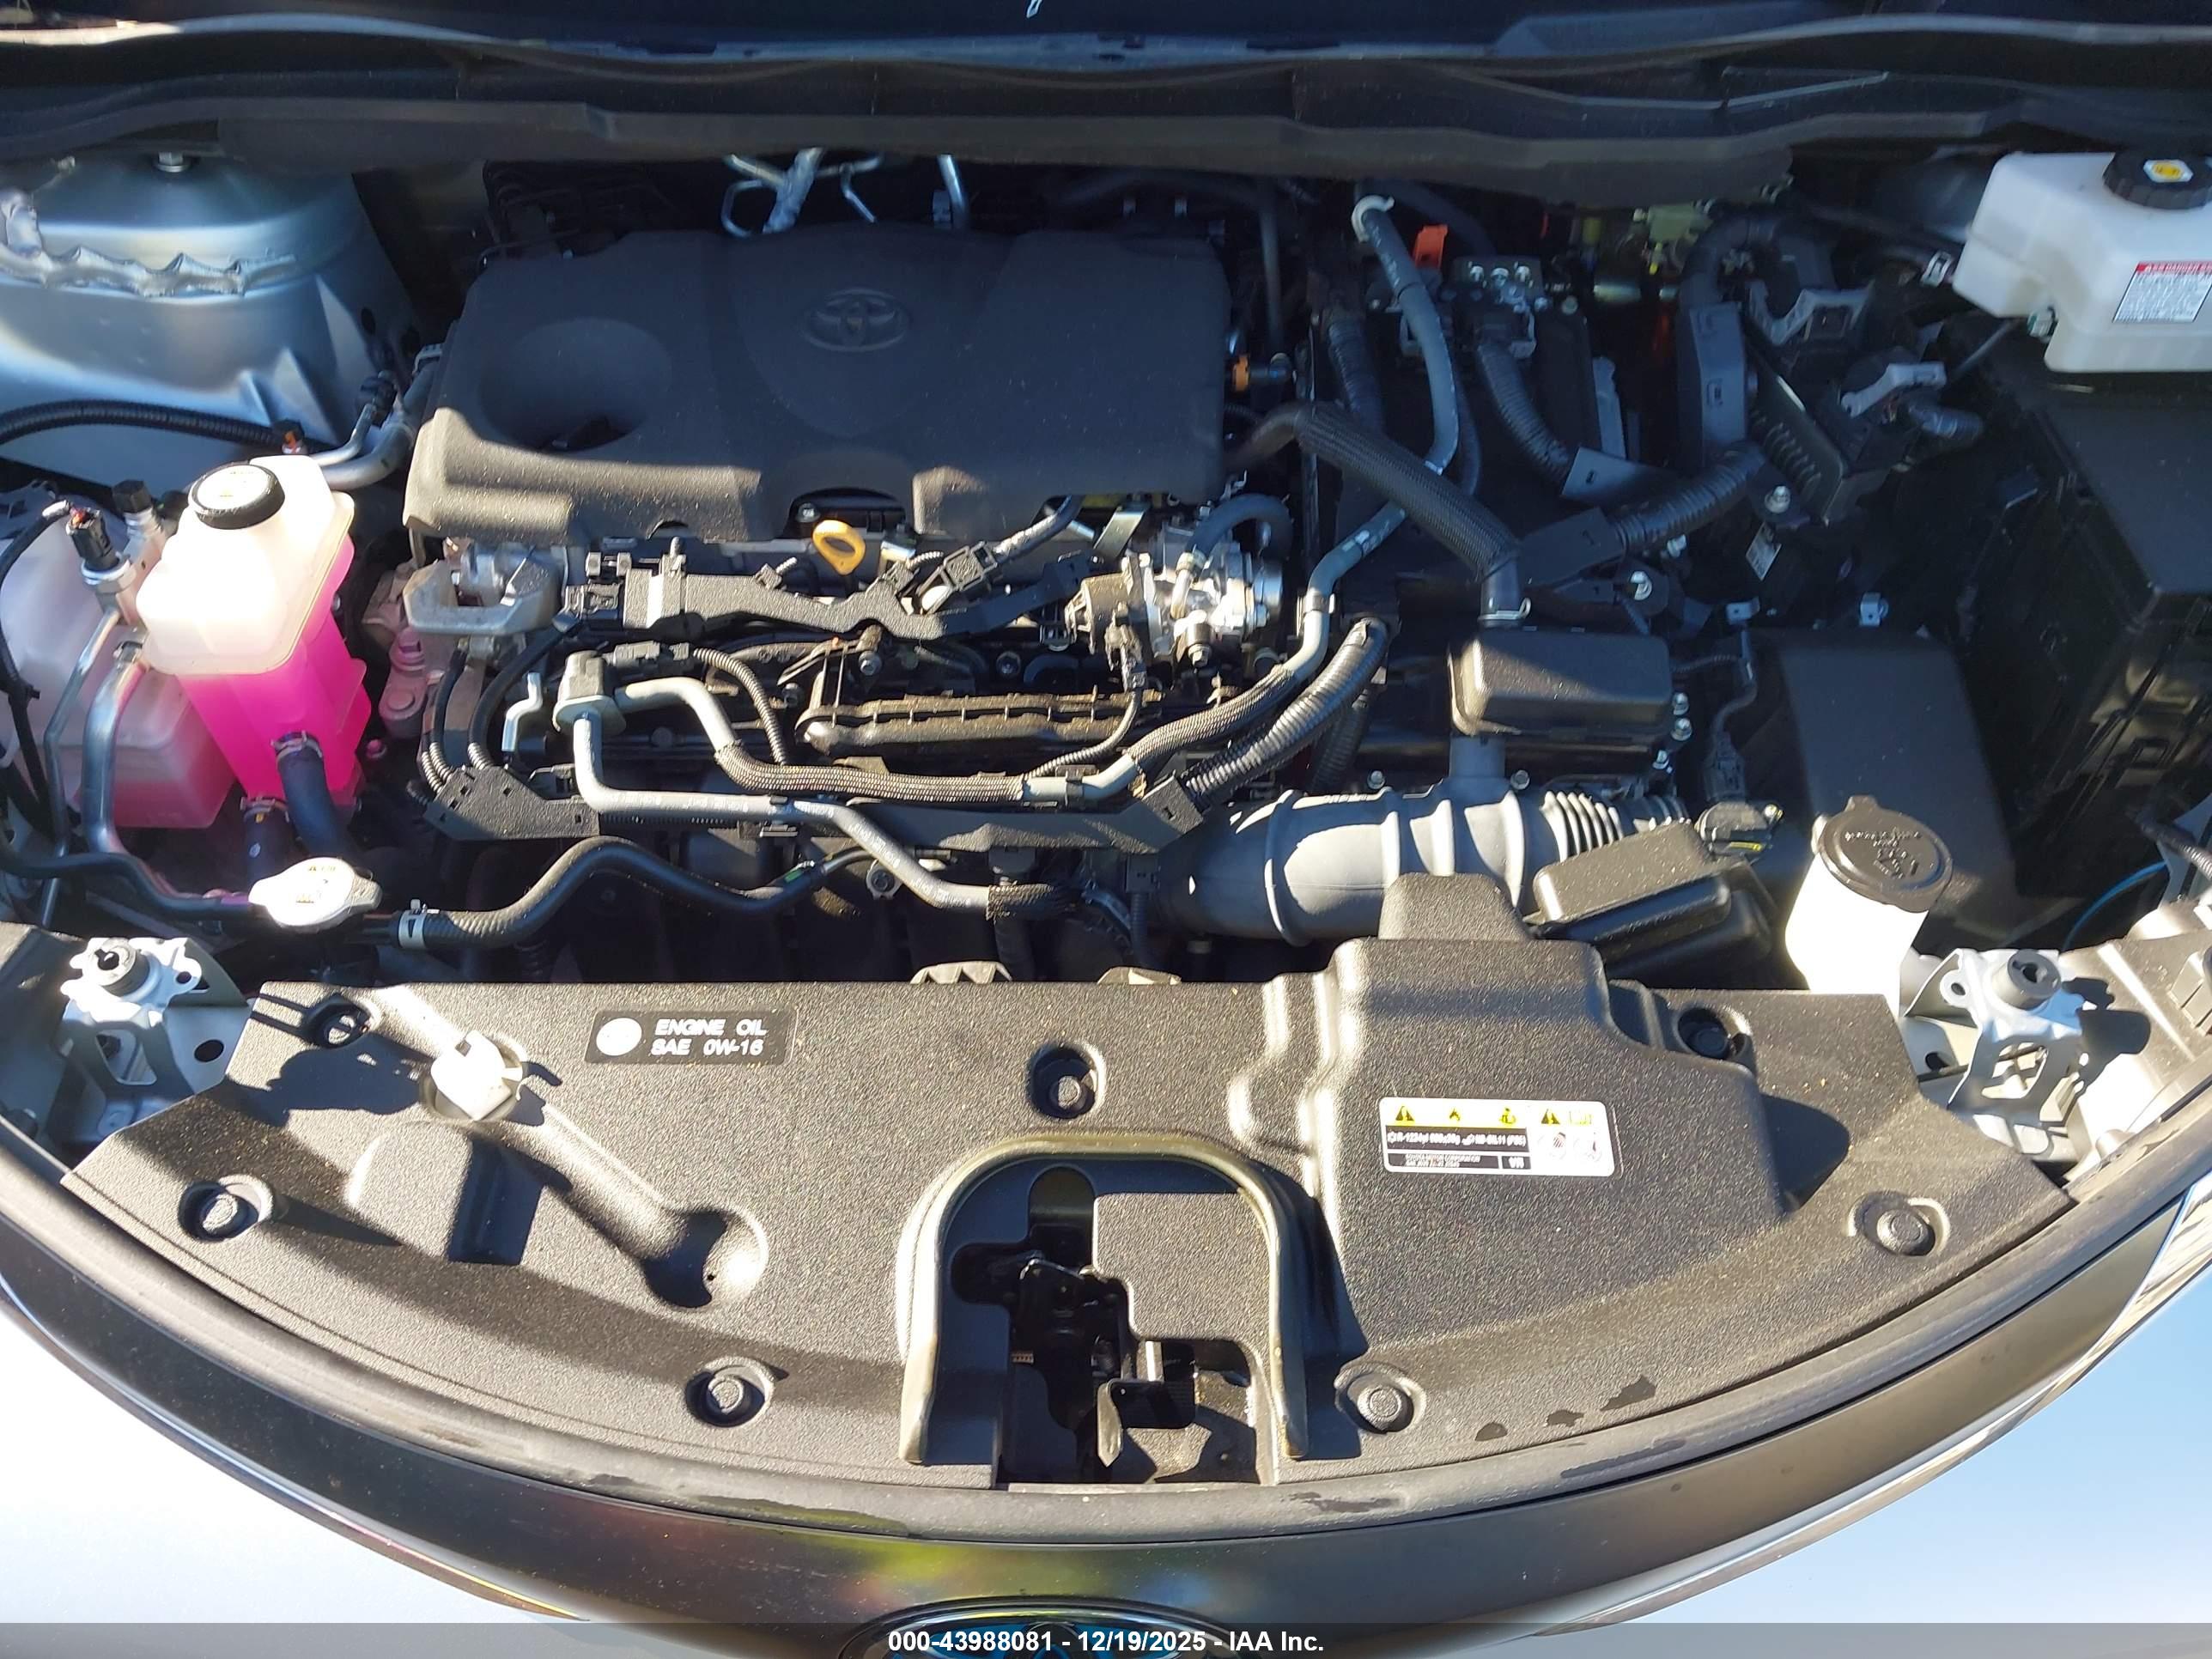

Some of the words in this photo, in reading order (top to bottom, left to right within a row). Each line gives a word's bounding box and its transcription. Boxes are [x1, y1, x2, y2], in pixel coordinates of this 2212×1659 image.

[655, 1018, 726, 1036] ENGINE
[736, 1018, 767, 1036] OIL
[651, 1038, 692, 1055] SAE
[703, 1039, 764, 1055] 0W-16
